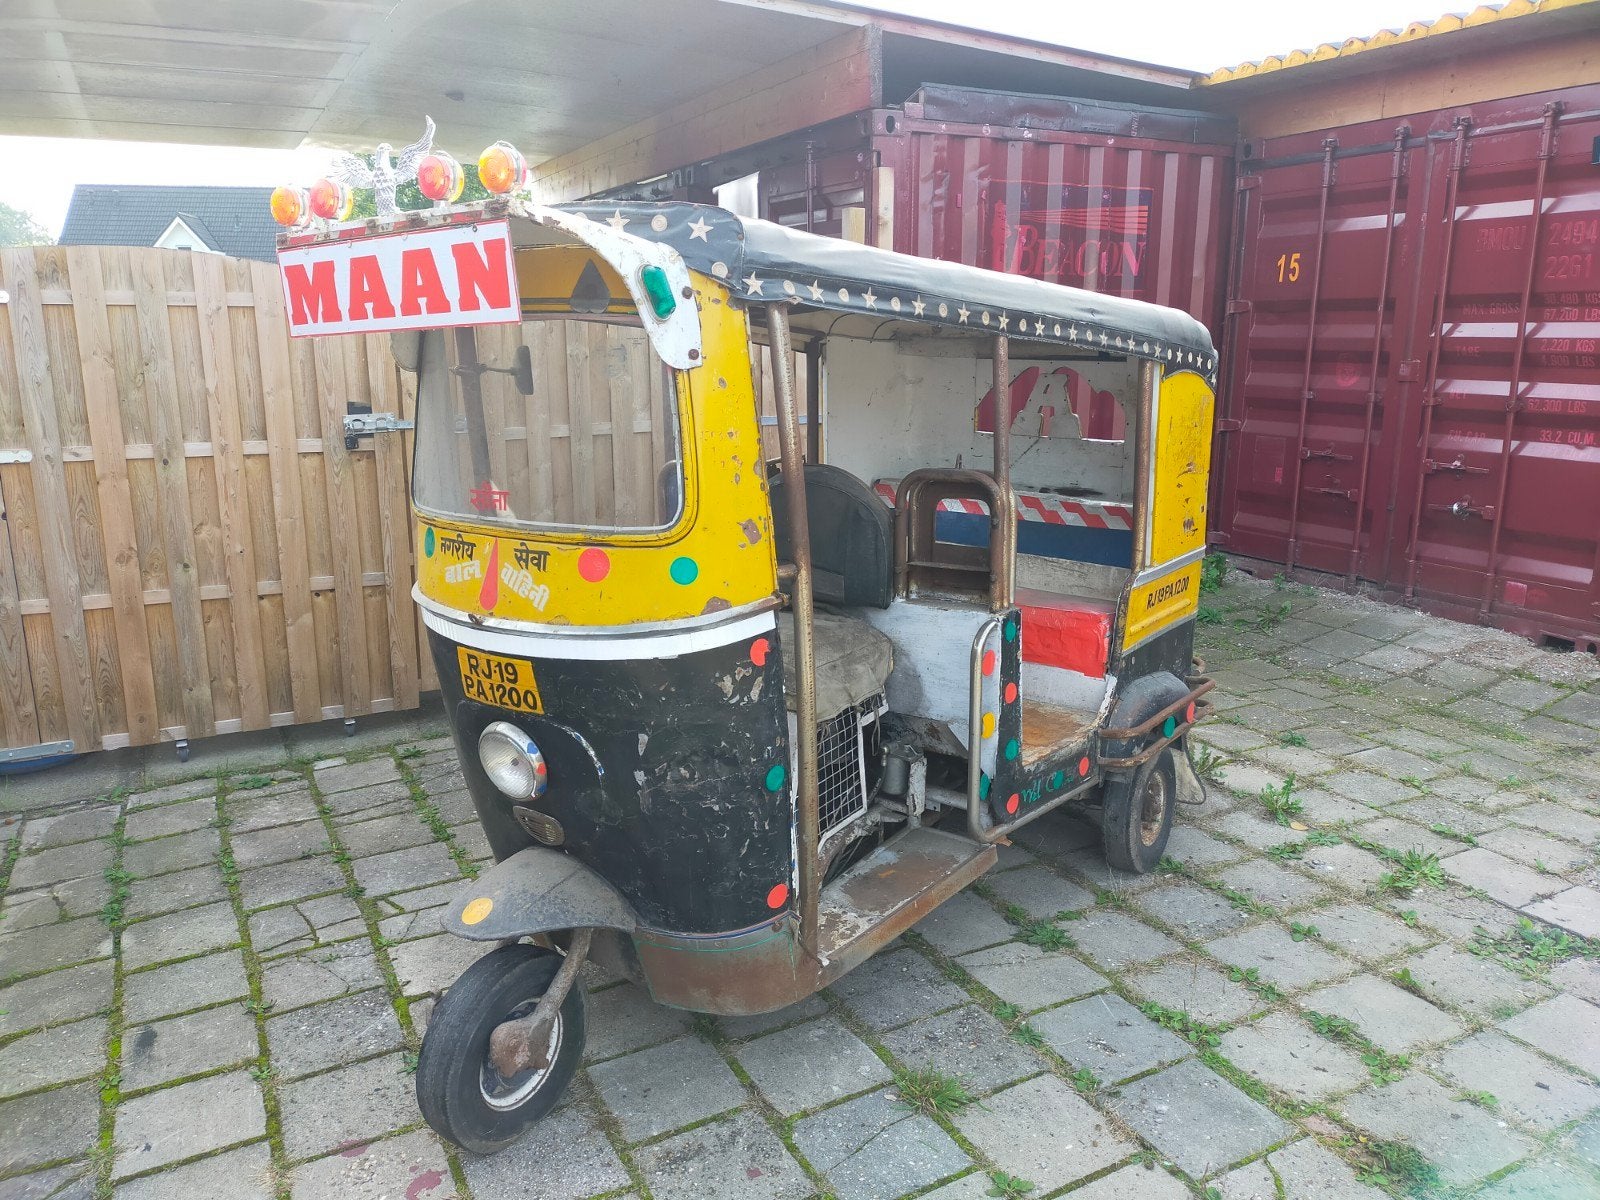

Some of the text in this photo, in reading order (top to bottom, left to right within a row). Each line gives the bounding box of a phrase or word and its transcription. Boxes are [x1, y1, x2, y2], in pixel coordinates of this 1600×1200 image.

[1010, 224, 1147, 277] BEACON
[284, 238, 511, 326] MAAN
[1277, 253, 1301, 282] 15
[1568, 400, 1587, 413] LBS
[514, 541, 551, 573] सेवा
